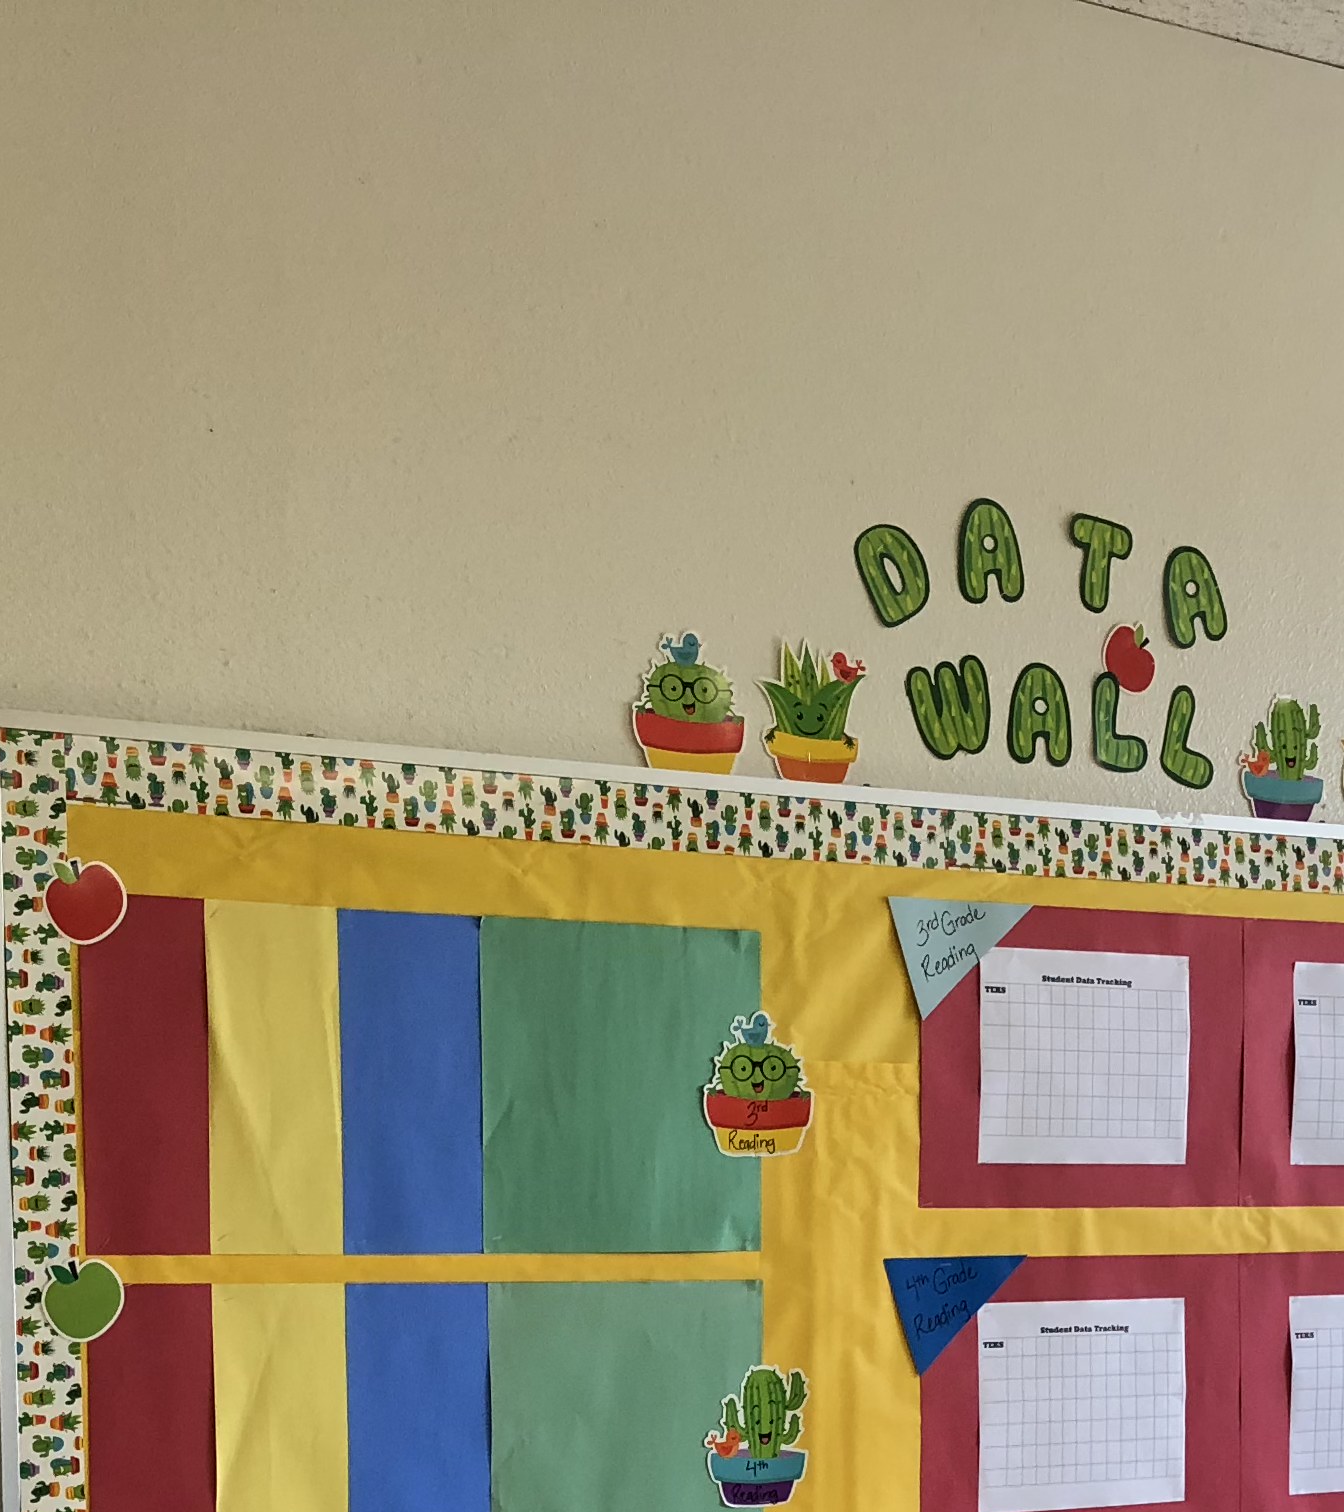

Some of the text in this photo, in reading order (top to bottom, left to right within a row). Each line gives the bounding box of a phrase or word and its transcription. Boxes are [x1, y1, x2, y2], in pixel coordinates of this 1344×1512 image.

[853, 497, 1229, 649] DATA
[905, 655, 1214, 790] WALL
[916, 904, 986, 947] 3rd Grade
[920, 942, 980, 983] Reading
[1042, 975, 1132, 988] Student Data Tracking
[746, 1101, 769, 1126] 3rd
[729, 1130, 776, 1154] Reading
[906, 1262, 979, 1300] 4th Grade
[913, 1300, 972, 1340] Reading
[1040, 1323, 1130, 1334] Student Data Tracking
[746, 1460, 769, 1478] 4th
